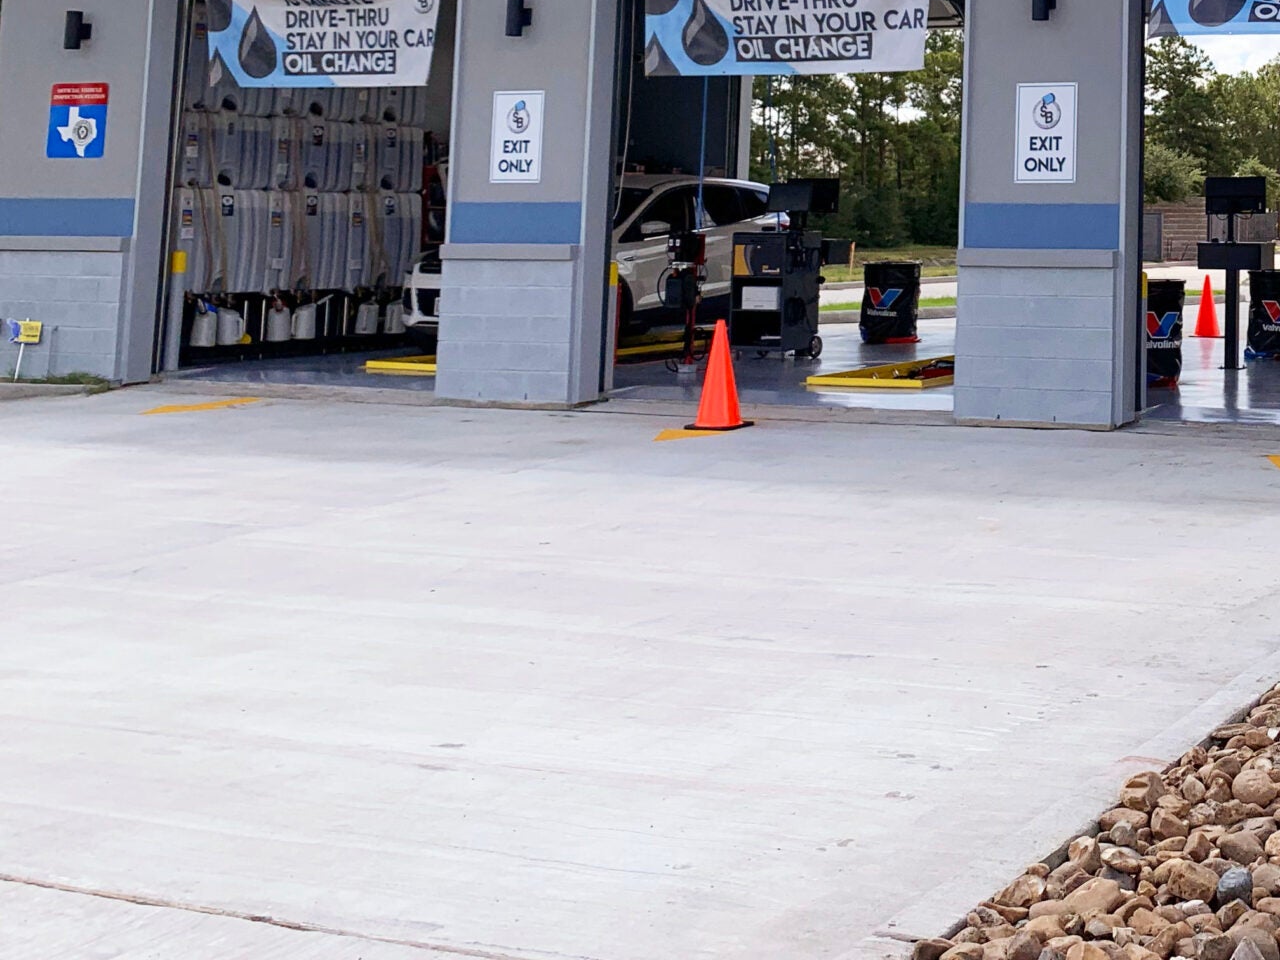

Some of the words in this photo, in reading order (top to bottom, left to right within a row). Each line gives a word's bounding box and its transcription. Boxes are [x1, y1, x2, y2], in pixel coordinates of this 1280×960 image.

[286, 7, 389, 29] DRIVE-THRU
[733, 14, 778, 36] STAY
[786, 13, 806, 34] IN
[816, 11, 878, 33] YOUR
[883, 8, 924, 29] CAR
[286, 32, 327, 50] STAY
[333, 31, 350, 49] IN
[359, 30, 400, 49] YOUR
[404, 28, 434, 48] CAR
[737, 40, 771, 60] OIL
[775, 36, 870, 60] CHANGE
[285, 53, 318, 73] OIL
[321, 52, 395, 73] CHANGE
[503, 140, 531, 153] EXIT
[1029, 136, 1063, 151] EXIT
[498, 159, 533, 173] ONLY
[1024, 157, 1066, 172] ONLY
[1145, 340, 1180, 350] alvolin
